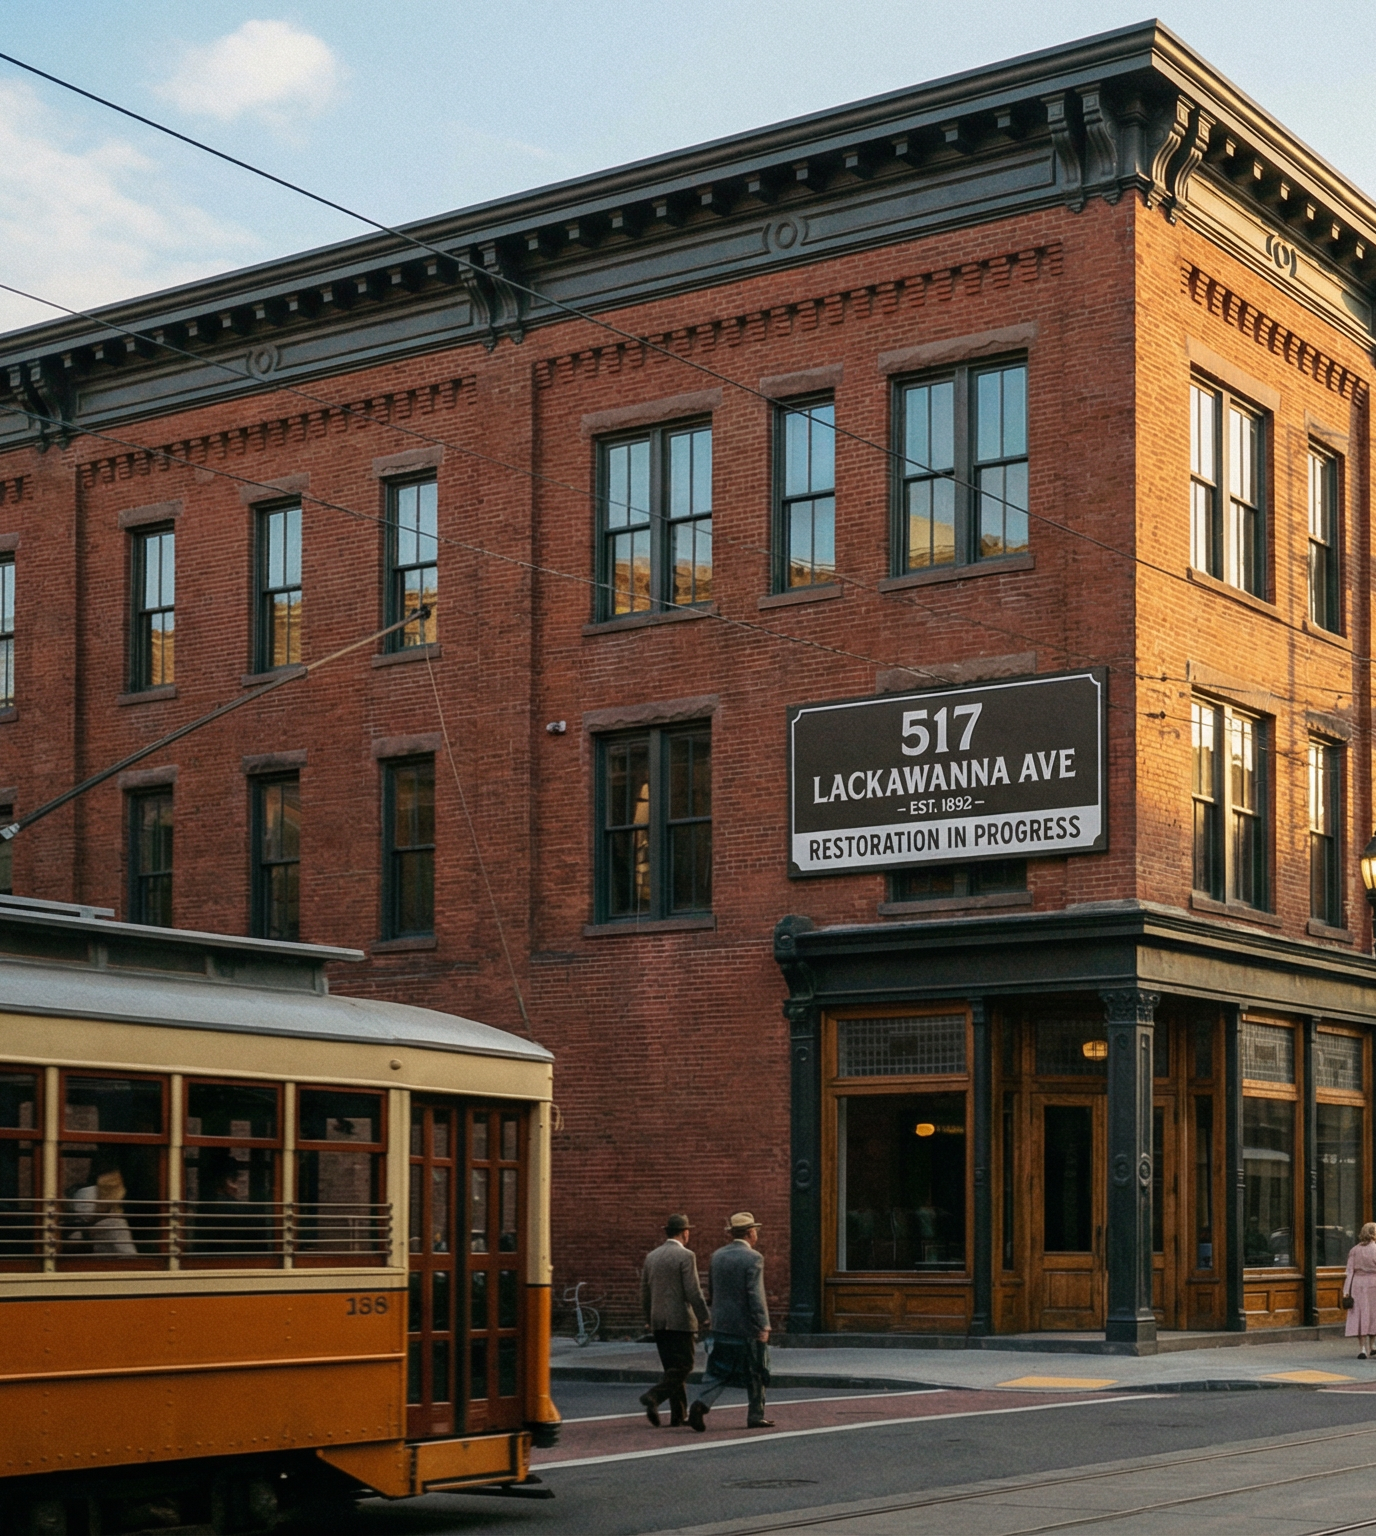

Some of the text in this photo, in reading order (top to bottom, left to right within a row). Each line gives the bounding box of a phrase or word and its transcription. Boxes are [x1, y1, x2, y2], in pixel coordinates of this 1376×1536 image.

[901, 702, 983, 757] 517
[813, 748, 1077, 804] LACKAWANNA AVE
[909, 796, 973, 815] EST. 1892
[809, 814, 1081, 862] RESTORATION IN PROGRESS
